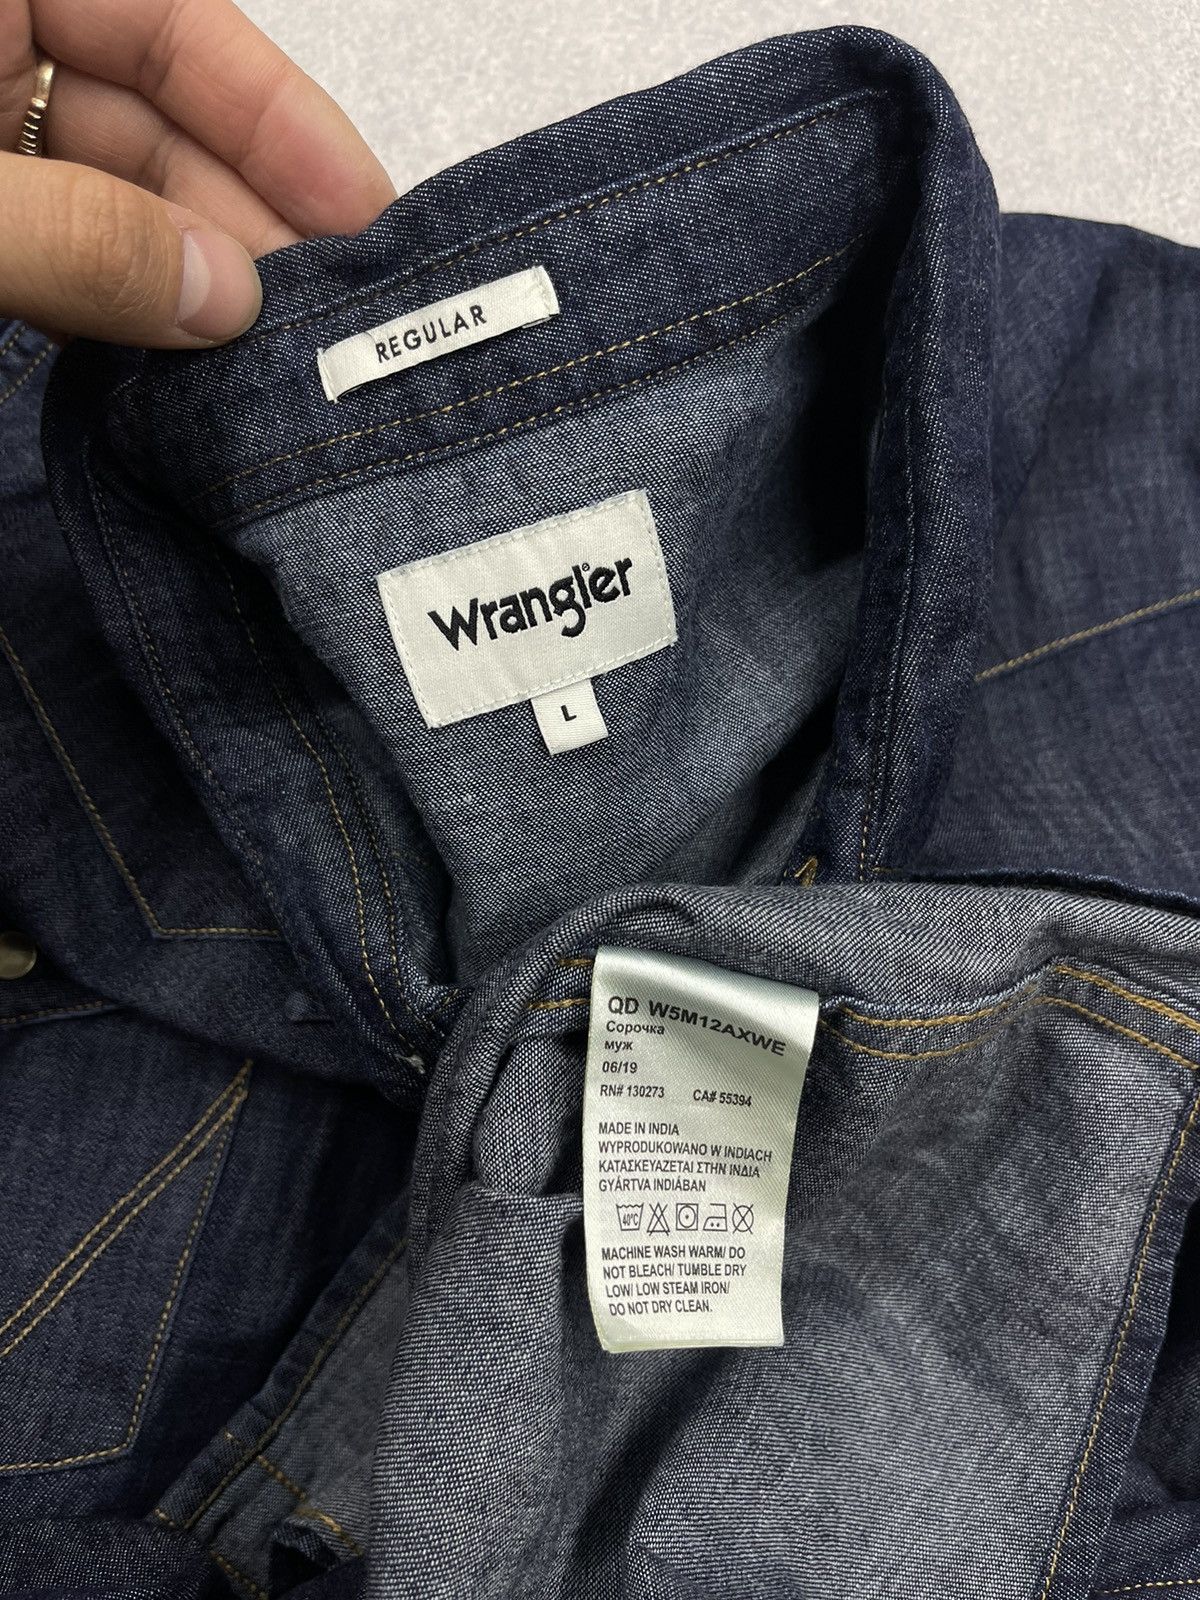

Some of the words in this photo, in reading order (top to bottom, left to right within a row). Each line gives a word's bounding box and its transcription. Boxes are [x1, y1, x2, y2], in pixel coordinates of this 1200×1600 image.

[375, 304, 486, 363] REGULAR
[427, 556, 633, 652] Wrangler
[562, 703, 577, 722] L
[606, 1020, 665, 1035] Сорочка
[608, 996, 639, 1014] QD
[648, 1000, 786, 1056] W5M12AXWE
[604, 1041, 633, 1053] муж
[602, 1061, 638, 1074] 06/19
[600, 1084, 624, 1097] RN#
[627, 1085, 665, 1098] 130273
[693, 1089, 717, 1102] CA#
[719, 1091, 752, 1107] 55394
[598, 1122, 631, 1134] MADE
[634, 1123, 646, 1135] IN
[648, 1123, 679, 1135] INDIA
[598, 1141, 708, 1156] WYPRODUKOWANO
[710, 1145, 723, 1156] W
[724, 1146, 772, 1162] INDIACH
[598, 1160, 693, 1173] ΚΑΤΑΣΚΕΥΑΖΕΤΑΙ
[697, 1162, 727, 1175] ΣΤΗΝ
[598, 1177, 651, 1192] GYÁRTVA
[653, 1176, 706, 1191] INDIÁBAN
[601, 1246, 652, 1260] MACHINE
[654, 1245, 686, 1258] WASH
[688, 1246, 726, 1258] WARM/
[729, 1246, 745, 1259] DO
[603, 1265, 626, 1279] NOT
[629, 1263, 675, 1277] BLEACH/
[678, 1263, 721, 1276] TUMBLE
[724, 1264, 747, 1276] DRY
[605, 1283, 634, 1298] LOW/
[636, 1282, 660, 1296] LOW
[663, 1282, 699, 1295] STEAM
[701, 1281, 730, 1294] IRON/
[609, 1303, 626, 1316] DO
[628, 1301, 650, 1315] NOT
[652, 1300, 673, 1314] DRY
[675, 1299, 713, 1313] CLEAN.
